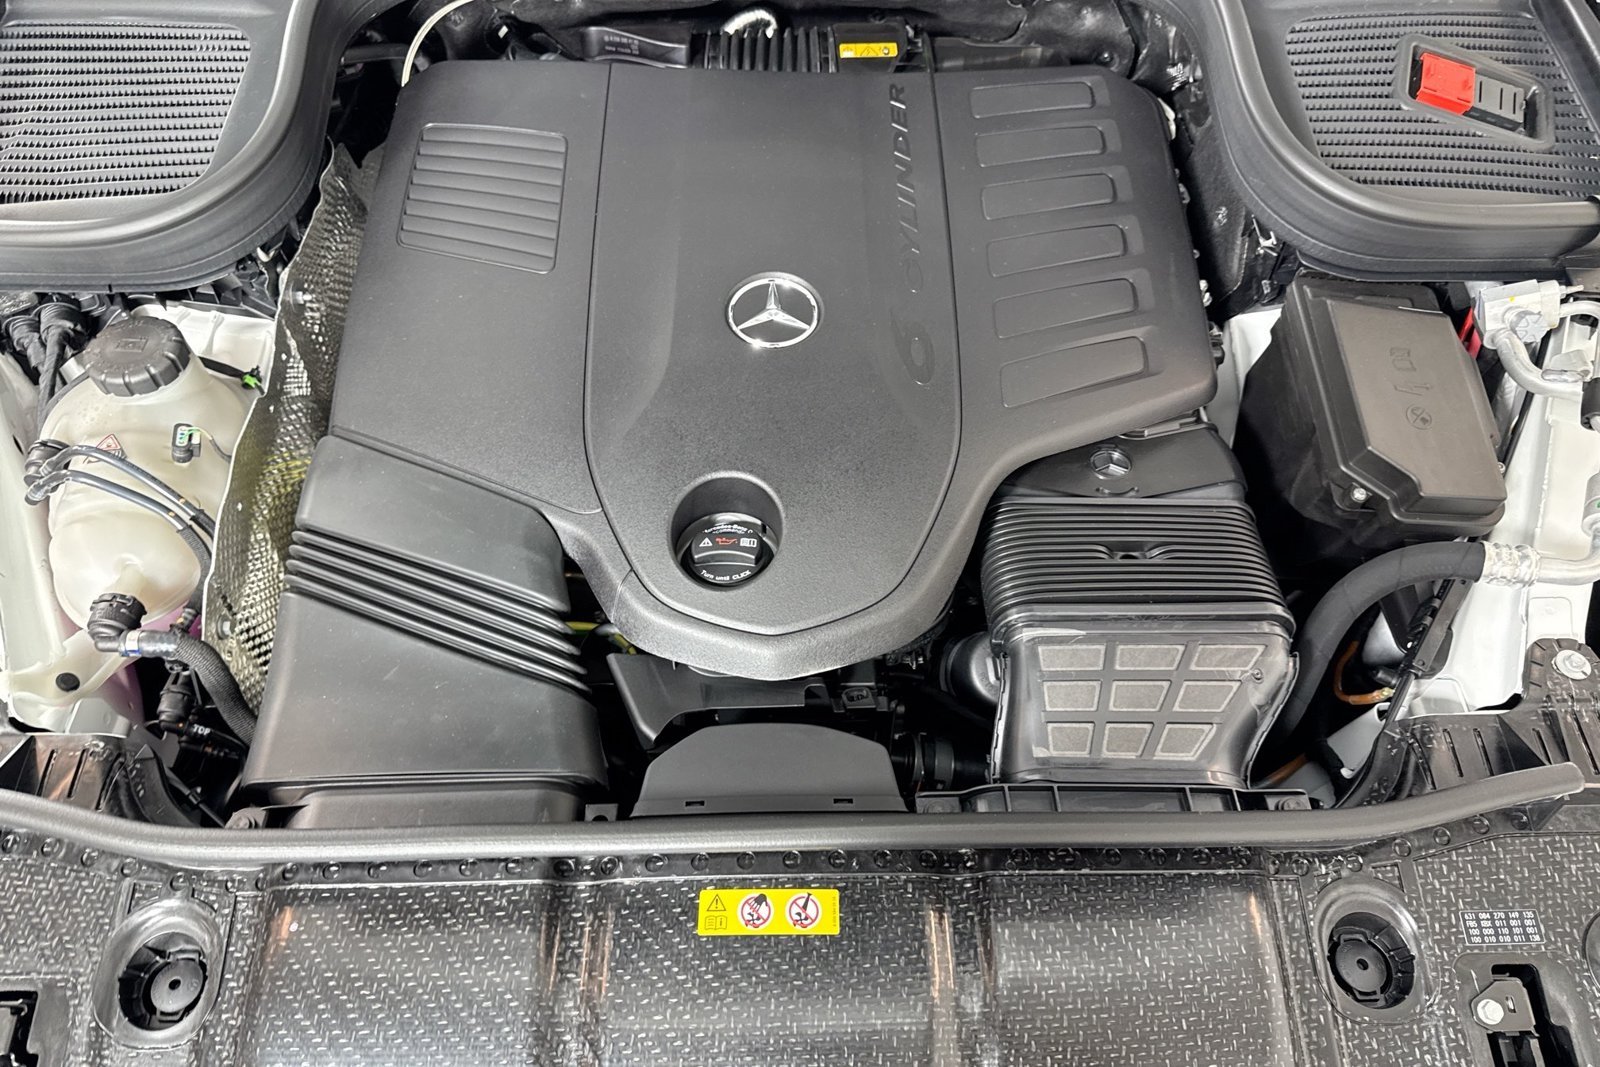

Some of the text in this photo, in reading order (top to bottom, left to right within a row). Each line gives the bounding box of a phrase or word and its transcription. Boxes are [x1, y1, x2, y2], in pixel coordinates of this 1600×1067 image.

[701, 569, 714, 580] Turn
[732, 569, 752, 580] CLICK
[193, 723, 211, 735] TOP
[1508, 911, 1519, 919] 149
[1498, 927, 1509, 935] 110
[1526, 926, 1538, 934] 001
